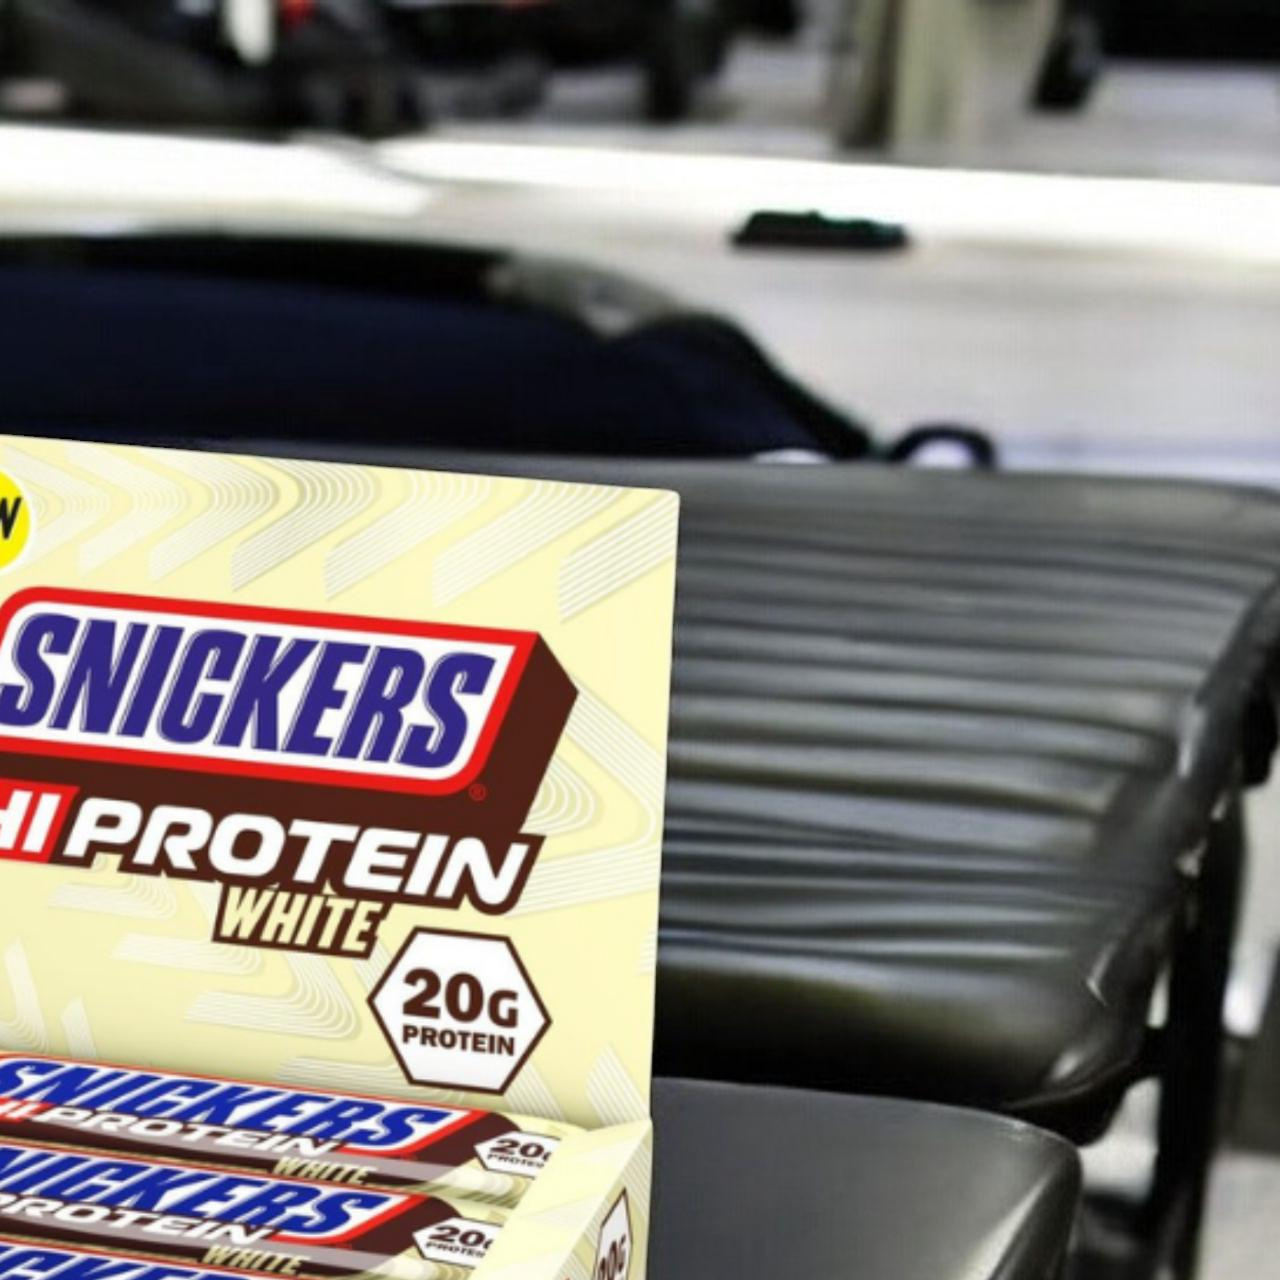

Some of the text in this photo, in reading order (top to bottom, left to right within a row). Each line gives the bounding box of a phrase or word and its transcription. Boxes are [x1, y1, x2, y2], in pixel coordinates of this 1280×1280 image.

[64, 795, 531, 908] PROTEIN
[219, 885, 384, 951] WHITE
[401, 967, 520, 1026] 20G
[401, 1024, 516, 1057] PROTEIN
[31, 1106, 340, 1158] PROTEIN
[272, 1155, 378, 1185] WHITE
[201, 1243, 311, 1276] WHITE
